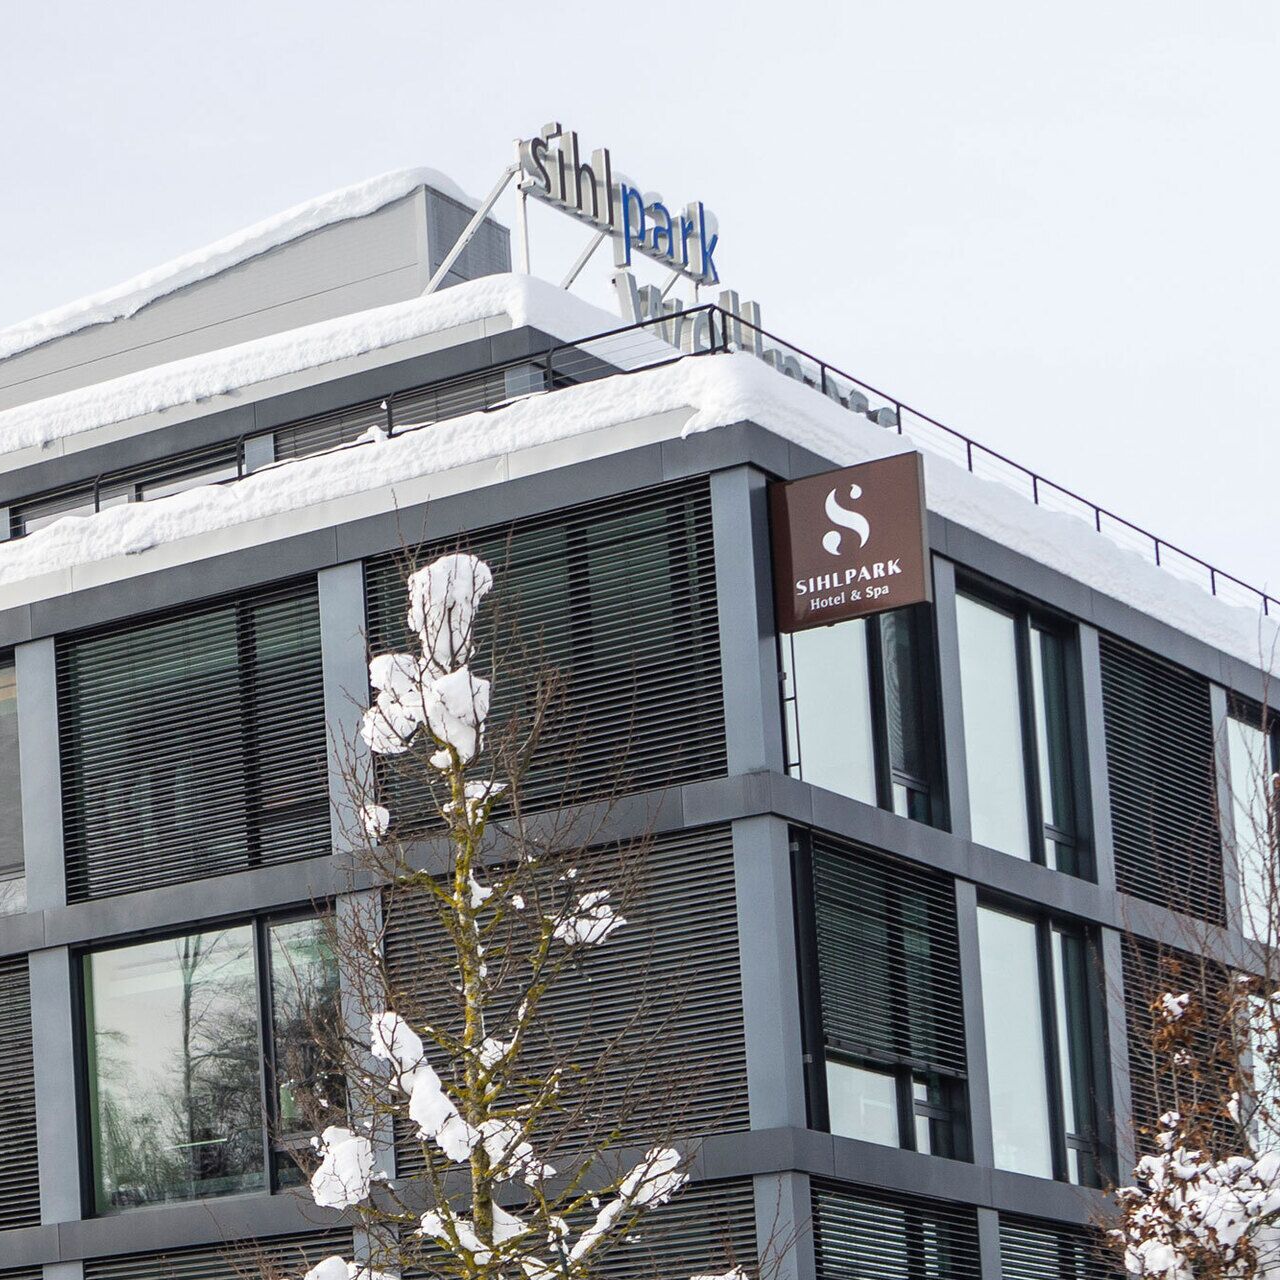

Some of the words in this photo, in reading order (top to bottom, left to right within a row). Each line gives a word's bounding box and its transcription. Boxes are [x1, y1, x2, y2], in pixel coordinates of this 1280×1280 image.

[796, 558, 902, 596] SIHLPARK
[810, 592, 845, 611] Hotel
[850, 589, 862, 602] &
[865, 585, 890, 599] Spa
